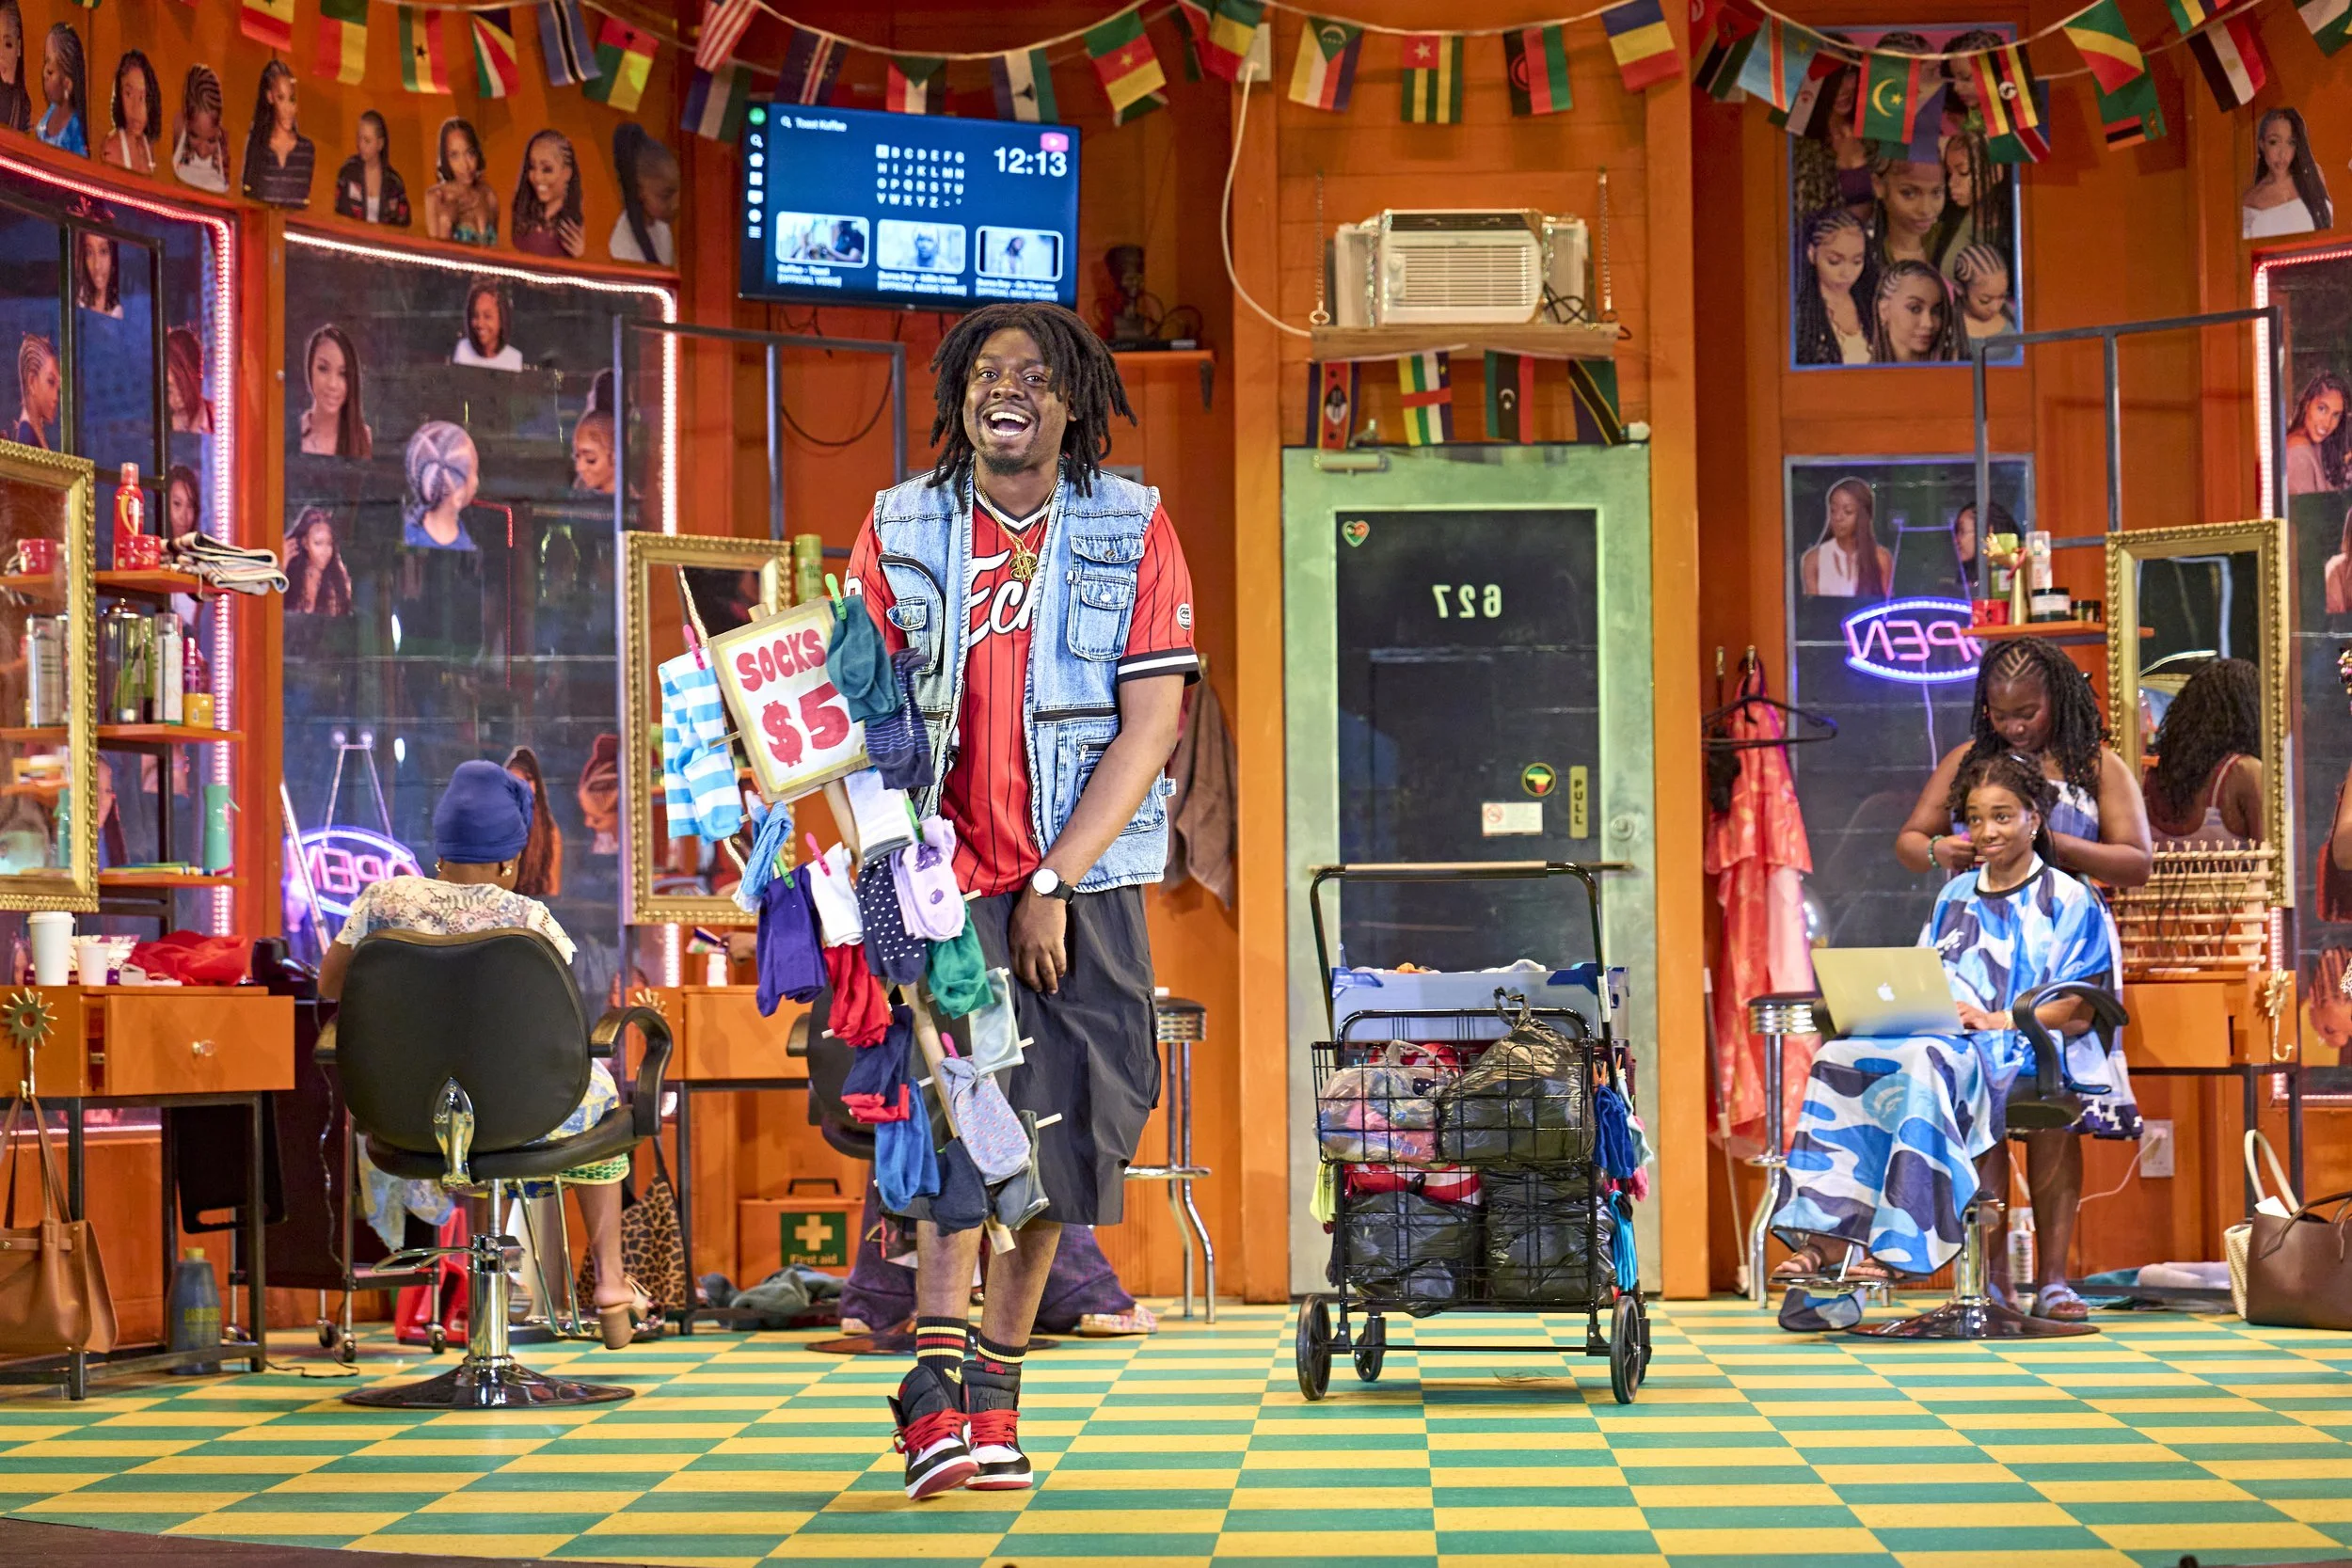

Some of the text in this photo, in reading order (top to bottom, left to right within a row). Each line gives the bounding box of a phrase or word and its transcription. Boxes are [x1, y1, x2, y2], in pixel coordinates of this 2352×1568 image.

[993, 146, 1068, 178] 12:13
[968, 548, 1035, 649] Ec
[736, 628, 826, 692] SOCKS
[762, 681, 850, 768] $5
[1574, 778, 1584, 826] PULL
[819, 1253, 837, 1265] aid
